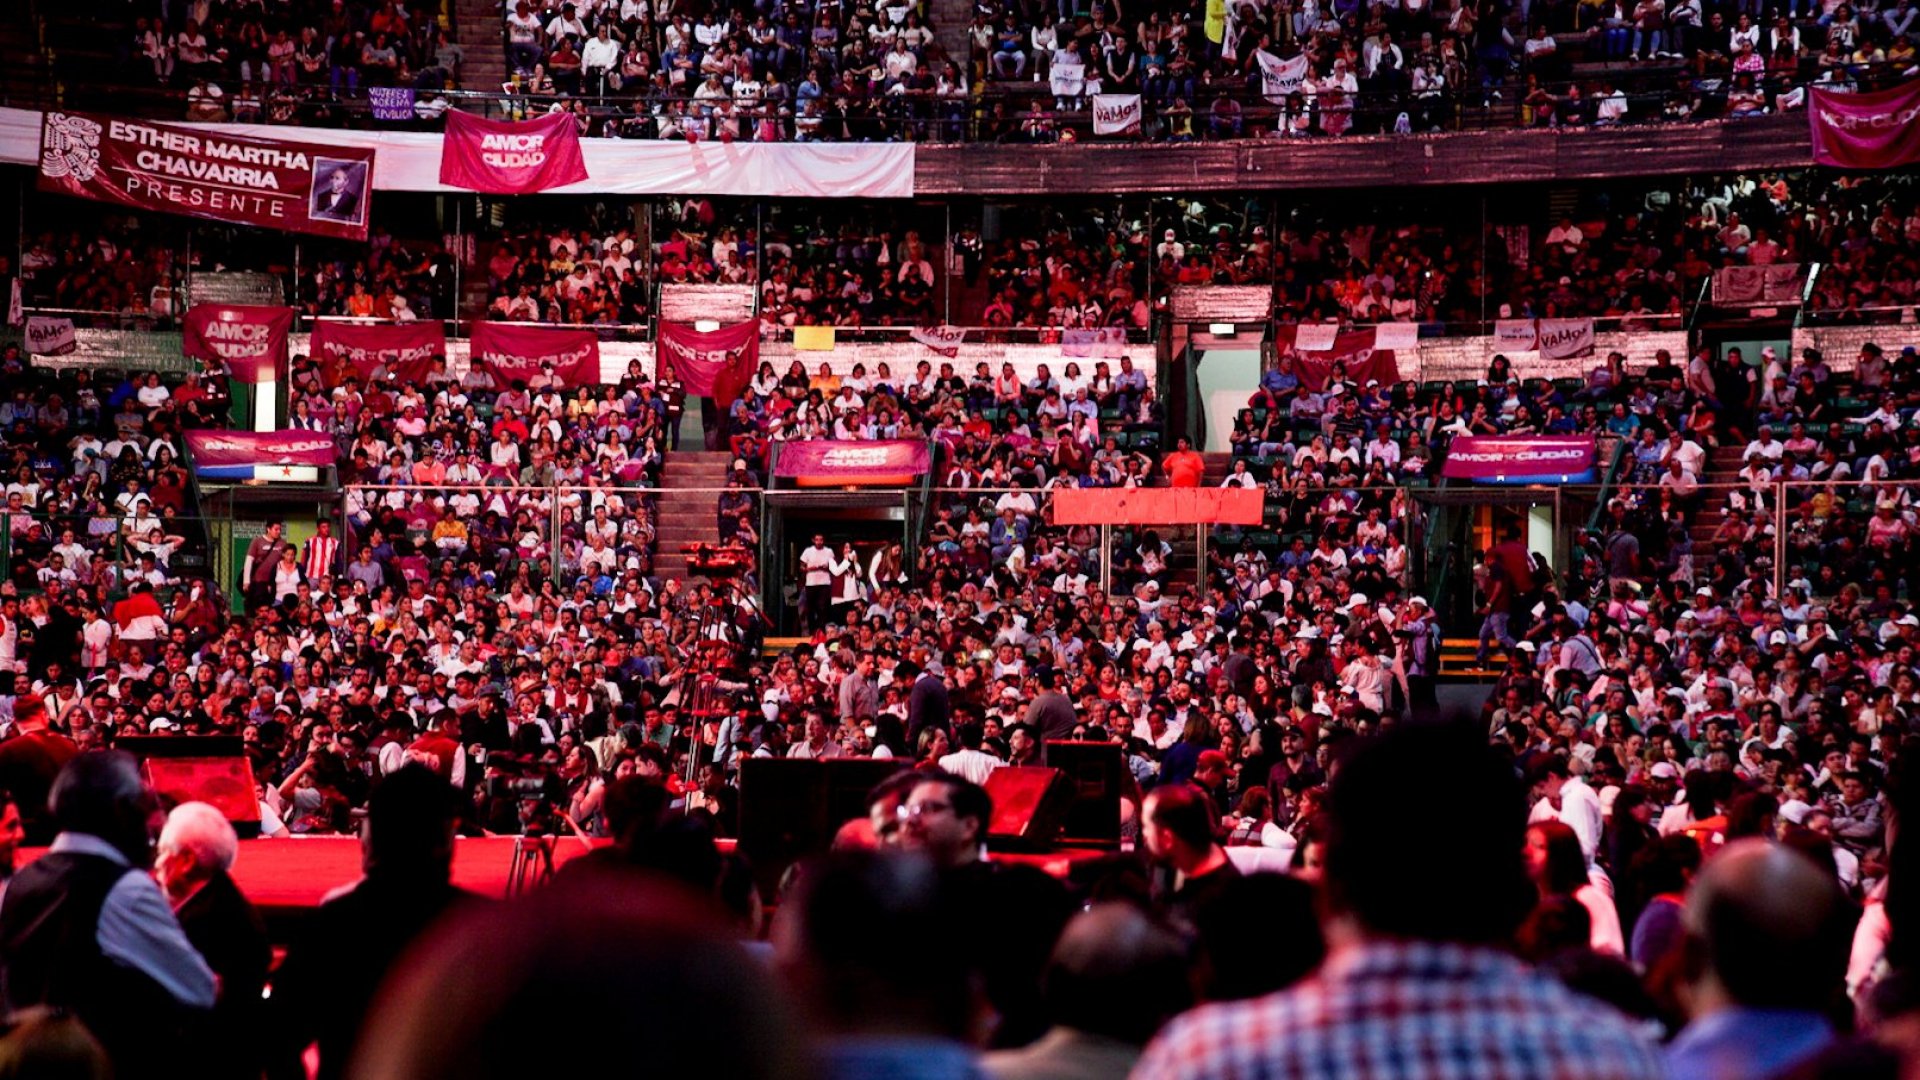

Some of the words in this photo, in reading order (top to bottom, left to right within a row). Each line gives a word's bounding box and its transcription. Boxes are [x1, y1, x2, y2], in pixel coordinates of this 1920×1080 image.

[1096, 101, 1138, 122] VAMOS
[109, 119, 200, 156] ESTHER
[204, 138, 310, 172] MARTHA
[480, 134, 544, 151] AMOR
[482, 152, 546, 169] CIUDAD
[136, 150, 279, 190] CHAVARRIA
[126, 177, 285, 218] PRESENTE
[205, 321, 269, 341] AMOR
[268, 440, 334, 453] CIUDAD
[823, 447, 889, 459] AMOR
[821, 457, 888, 467] CIUDAD
[1448, 452, 1504, 462] AMOR
[1515, 449, 1585, 461] CIUDAD
